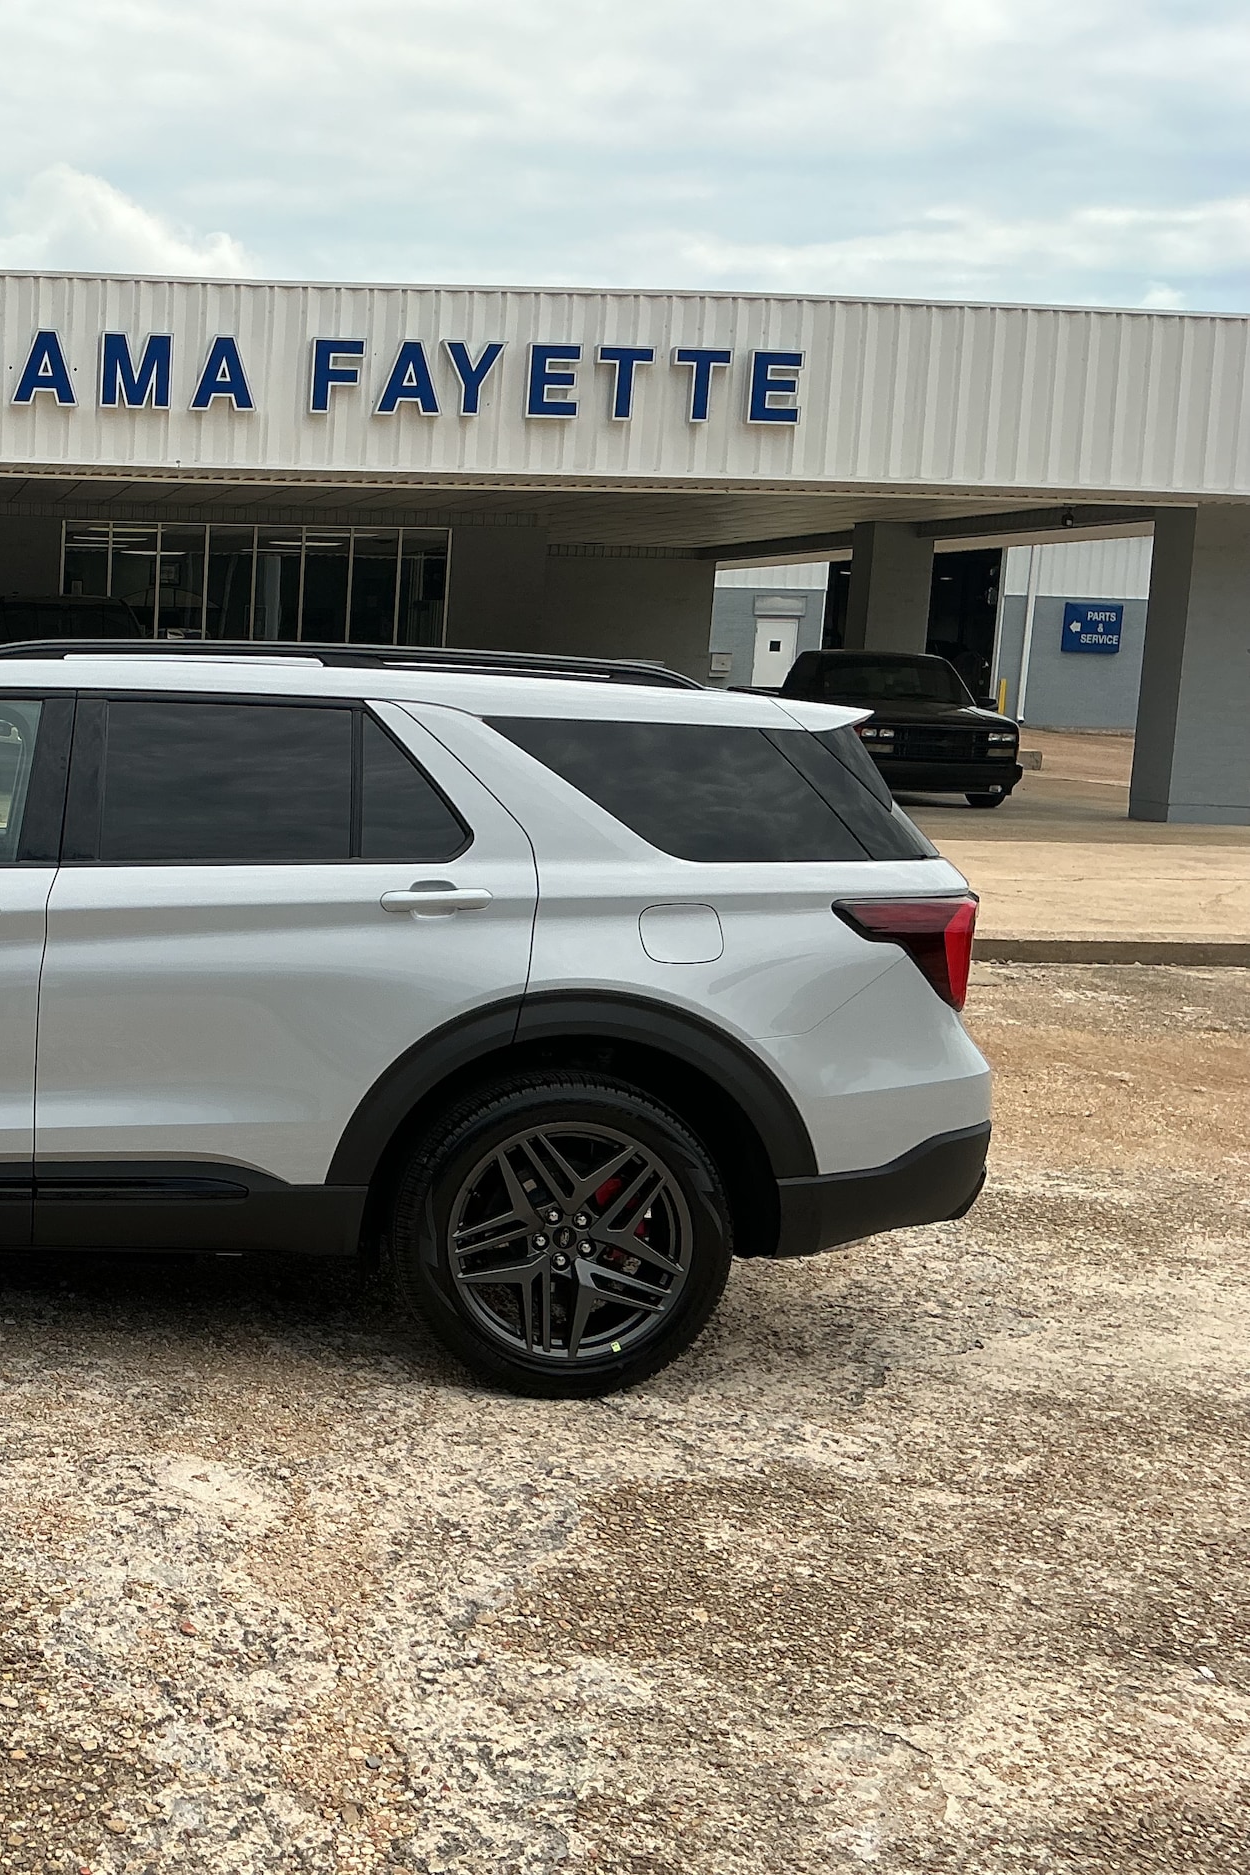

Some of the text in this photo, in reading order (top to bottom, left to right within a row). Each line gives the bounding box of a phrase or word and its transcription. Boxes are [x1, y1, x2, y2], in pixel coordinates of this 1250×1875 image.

[307, 336, 806, 426] FAYETTE
[1087, 611, 1116, 622] PARTS
[1097, 623, 1104, 633] &
[1080, 633, 1119, 644] SERVICE
